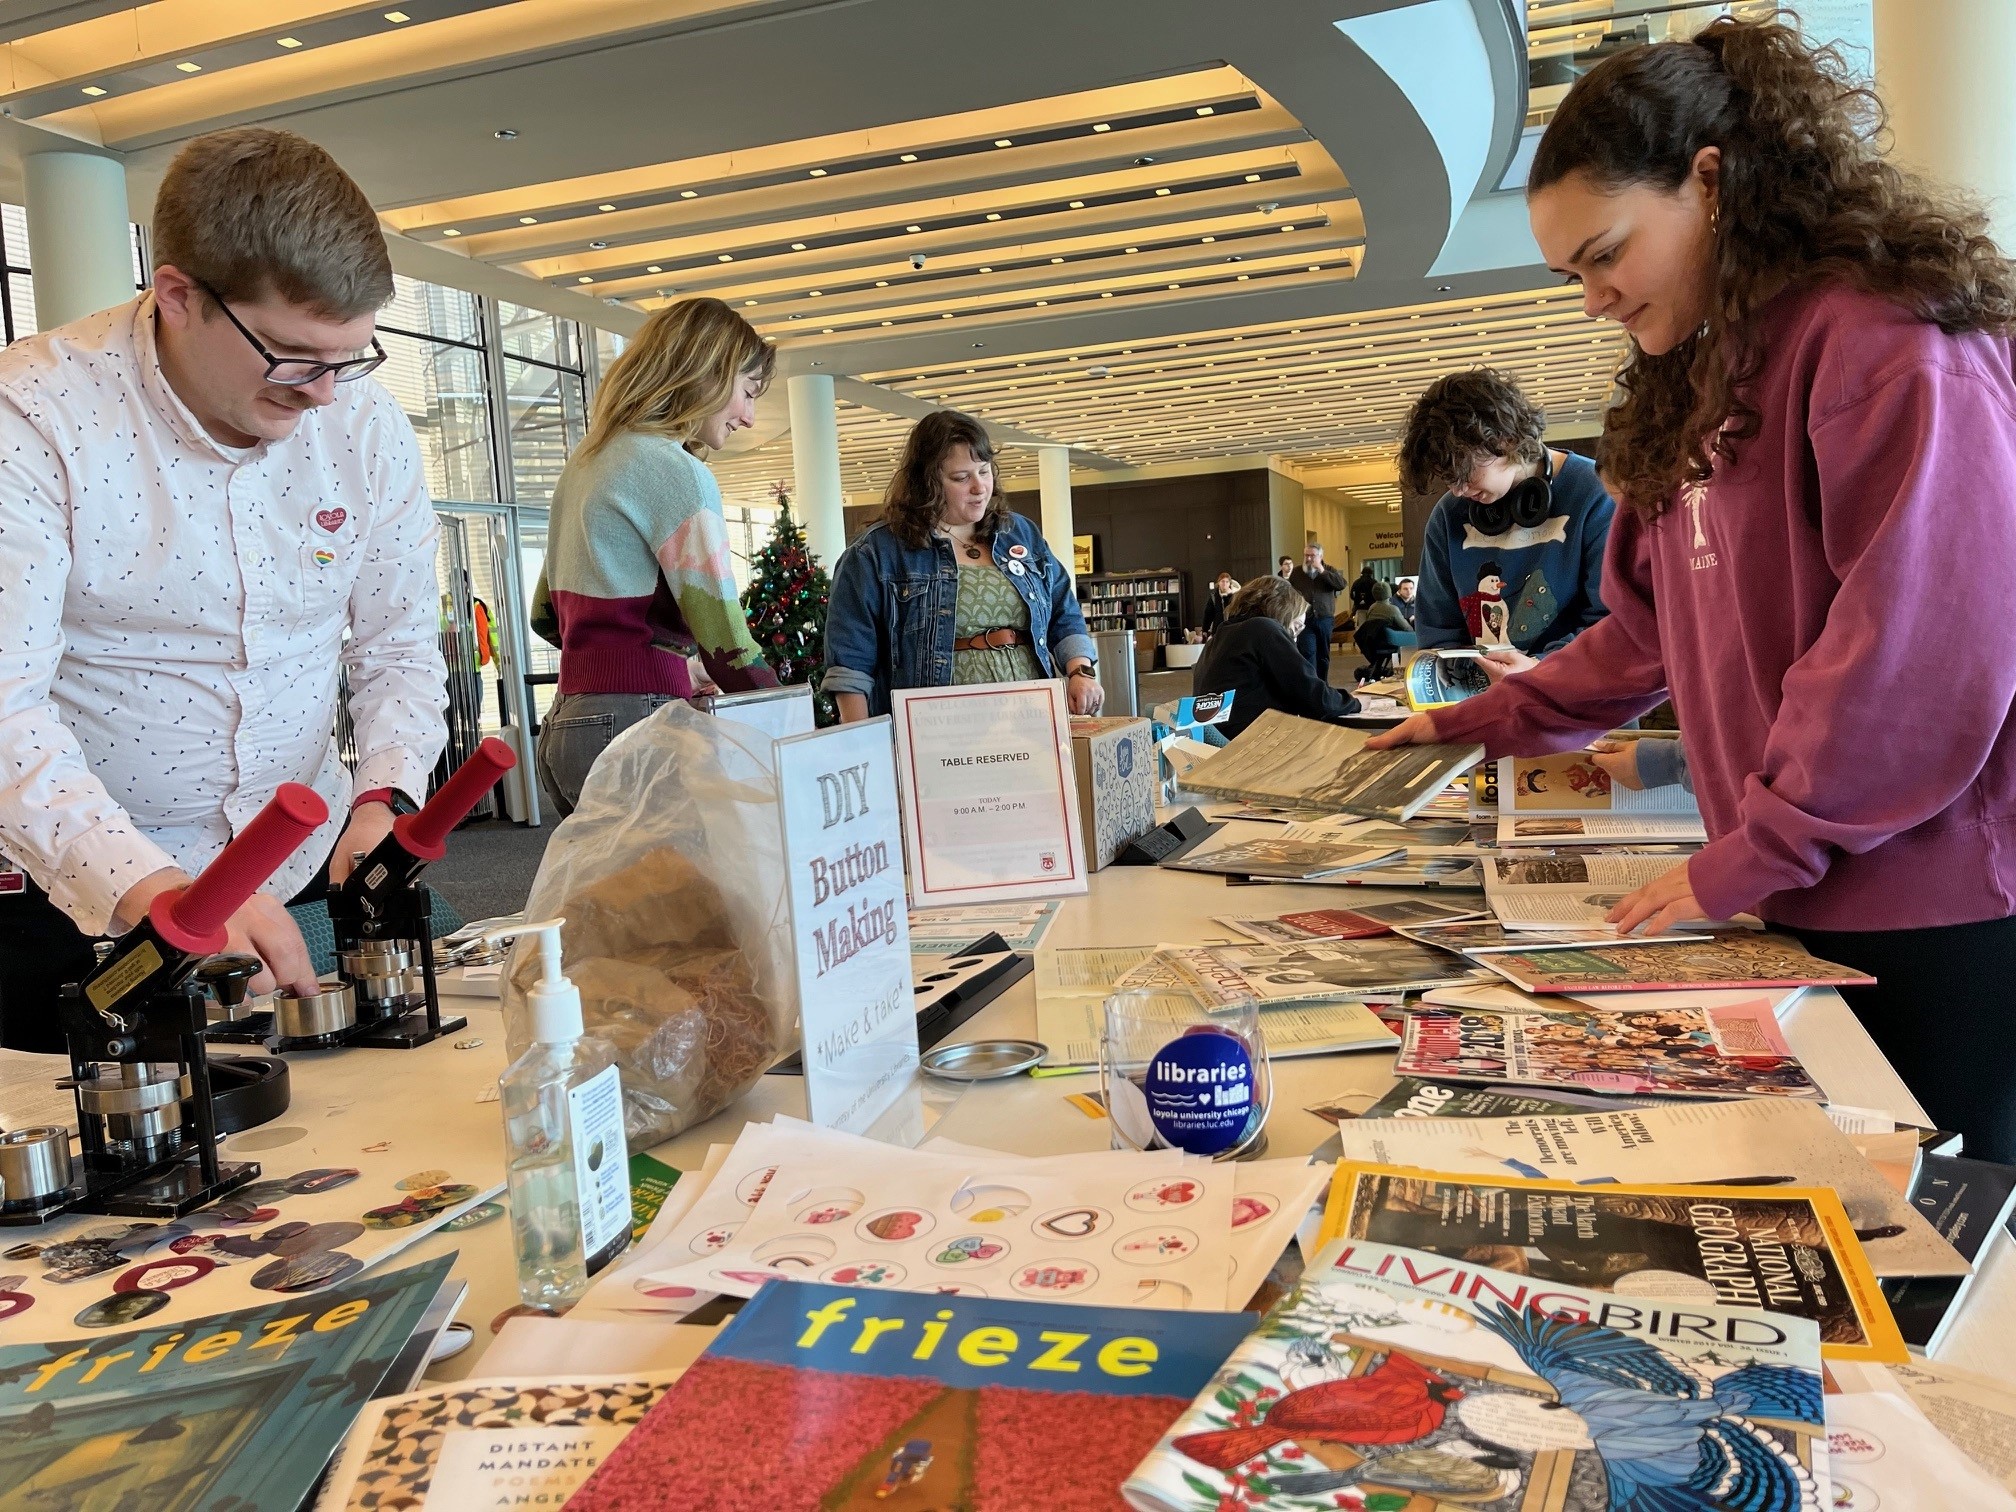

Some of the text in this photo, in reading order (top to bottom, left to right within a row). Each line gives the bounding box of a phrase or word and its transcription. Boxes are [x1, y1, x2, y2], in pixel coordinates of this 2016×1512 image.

[1368, 541, 1399, 550] Cudahy
[940, 752, 1030, 768] TABLE RESERVED
[817, 761, 870, 830] DIY
[979, 796, 1001, 804] TODAY
[953, 807, 969, 815] 9:00
[809, 839, 890, 908] Button
[812, 897, 898, 979] Making
[1157, 1061, 1246, 1083] libraries
[1153, 1105, 1250, 1121] loyola university chicago
[1173, 1118, 1235, 1130] libraries.luc.edu
[1505, 1119, 1523, 1137] The
[1556, 1118, 1580, 1135] left.
[1584, 1116, 1608, 1134] Will
[1608, 1114, 1640, 1150] America
[1621, 1113, 1655, 1144] follow?
[1525, 1118, 1557, 1164] Democrats
[1541, 1118, 1578, 1165] are moving
[1527, 1194, 1548, 1237] Extinction
[1550, 1195, 1573, 1226] Toward
[1574, 1196, 1600, 1239] The March
[1688, 1204, 1765, 1311] GEOGRAPHI
[1745, 1226, 1804, 1306] NATIONAL
[24, 1300, 370, 1393] frieze
[795, 1297, 1160, 1377] frieze
[1658, 1337, 1691, 1345] WINTER
[489, 1440, 595, 1454] DISTANT
[478, 1457, 599, 1471] MANDATE
[493, 1475, 577, 1488] POEMS
[496, 1492, 566, 1505] ANGE
